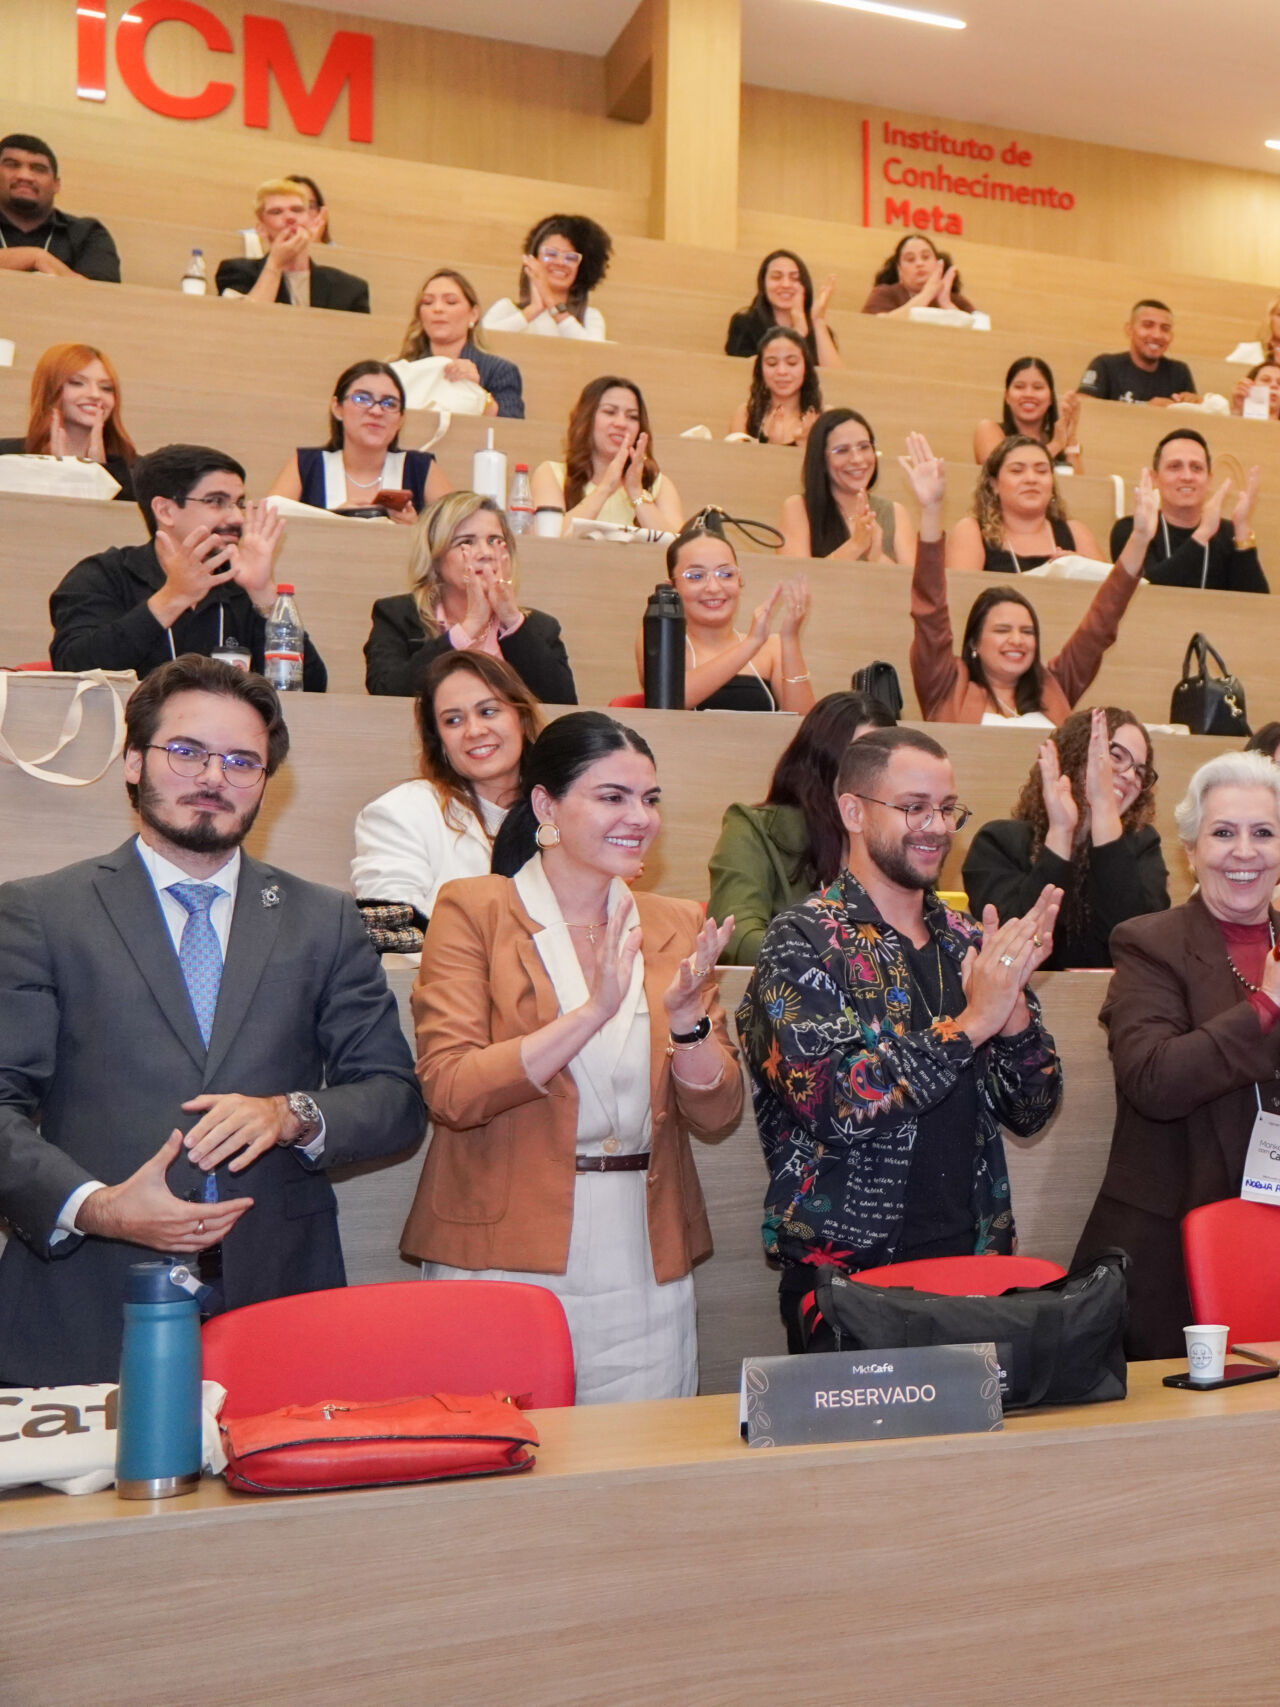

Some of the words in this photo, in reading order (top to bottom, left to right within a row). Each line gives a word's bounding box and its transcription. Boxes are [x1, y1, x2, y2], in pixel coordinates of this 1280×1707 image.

[76, 0, 374, 144] ICM
[882, 120, 995, 162] Instituto
[1001, 141, 1033, 168] de
[882, 156, 1076, 211] Conhecimento
[884, 196, 964, 236] Meta
[815, 1384, 936, 1409] RESERVADO
